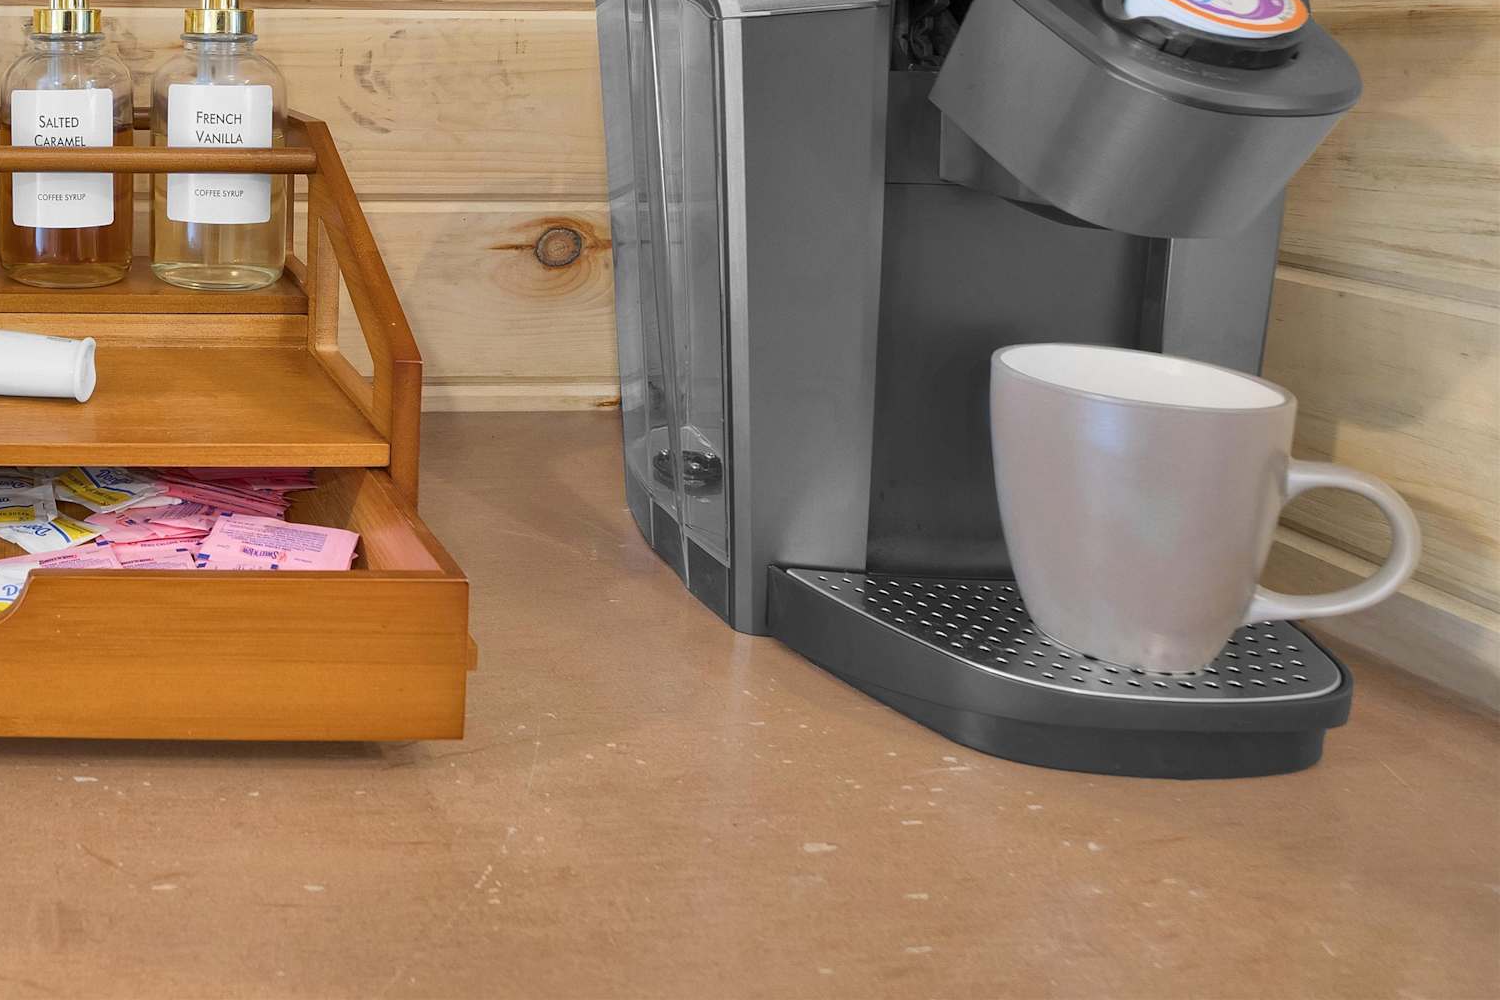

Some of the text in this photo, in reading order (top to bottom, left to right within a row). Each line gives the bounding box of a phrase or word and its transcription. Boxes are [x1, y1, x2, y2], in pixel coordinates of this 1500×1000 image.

[39, 115, 80, 129] SALTED
[196, 111, 243, 125] FRENCH
[34, 134, 87, 147] CARAMEL
[196, 130, 244, 144] VANILLA
[37, 193, 86, 201] COFFEE SYRUP
[194, 188, 245, 198] COFFEE SYRUP
